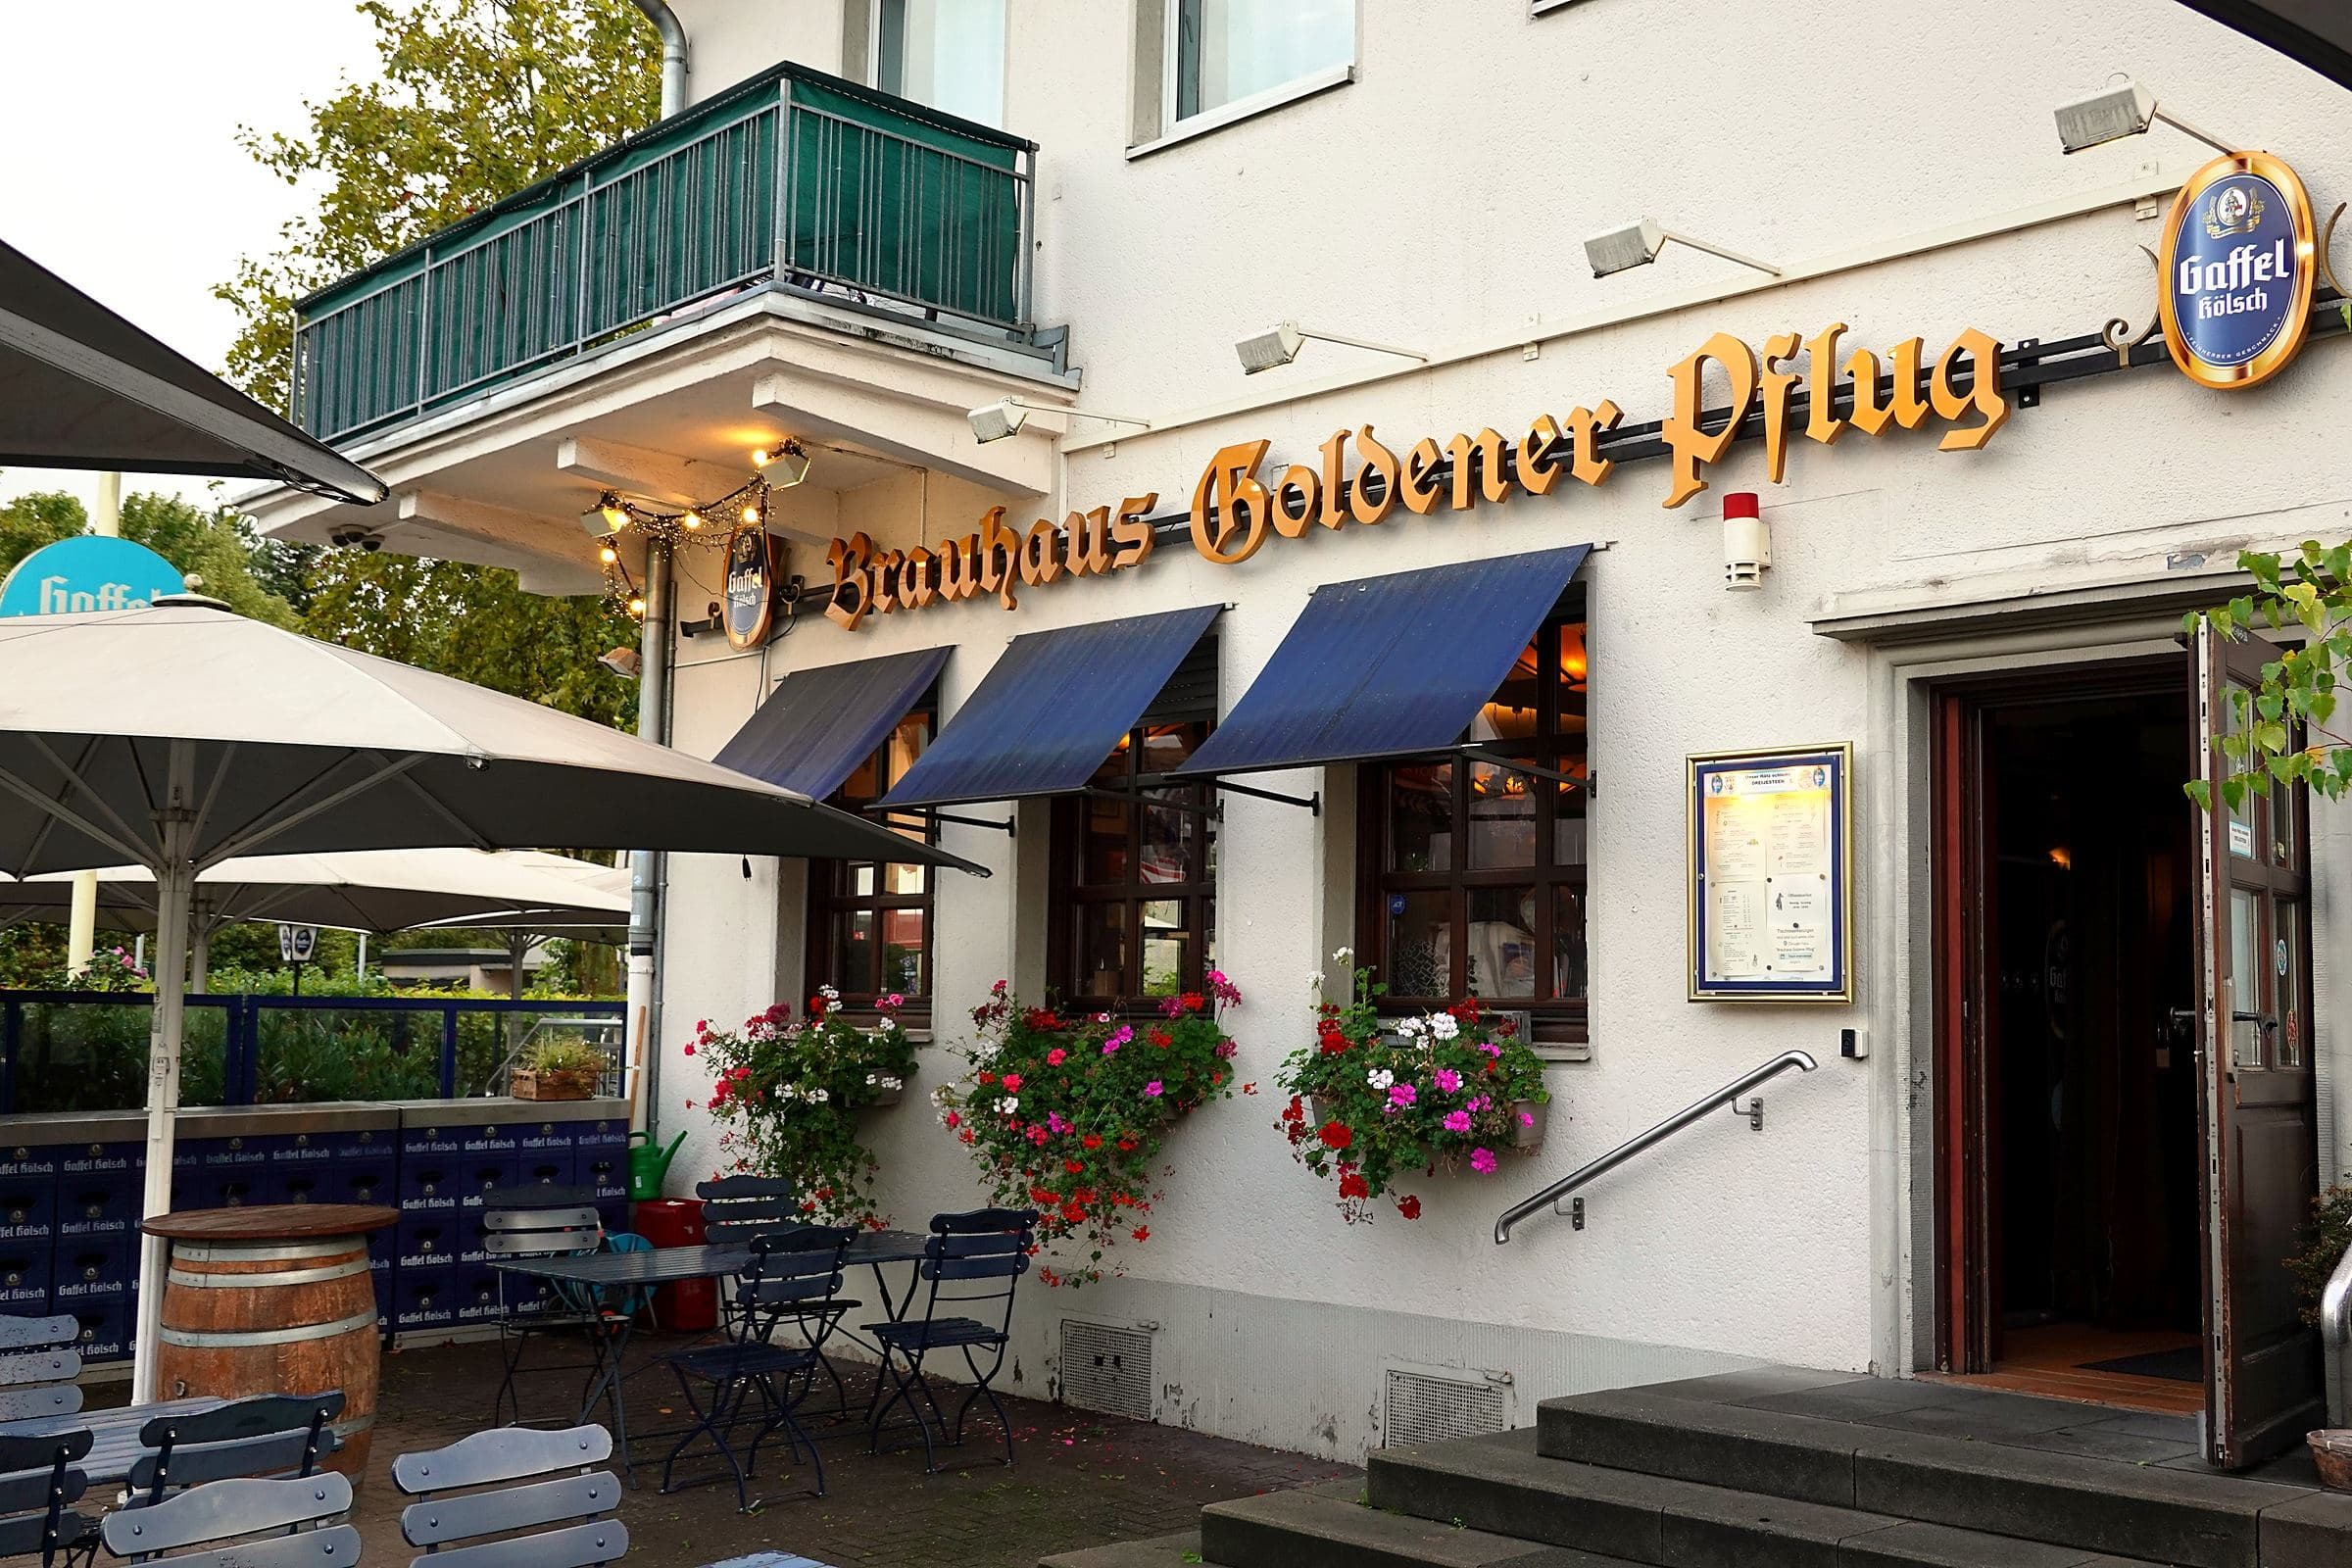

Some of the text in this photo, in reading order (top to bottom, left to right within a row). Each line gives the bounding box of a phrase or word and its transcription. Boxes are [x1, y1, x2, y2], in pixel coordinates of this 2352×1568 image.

[2180, 237, 2290, 295] Gaffel
[2198, 287, 2268, 319] Kölsch
[824, 322, 2012, 632] Brauhaus Goldener Pflug
[39, 575, 162, 615] Gaff
[728, 566, 763, 594] Gaffel
